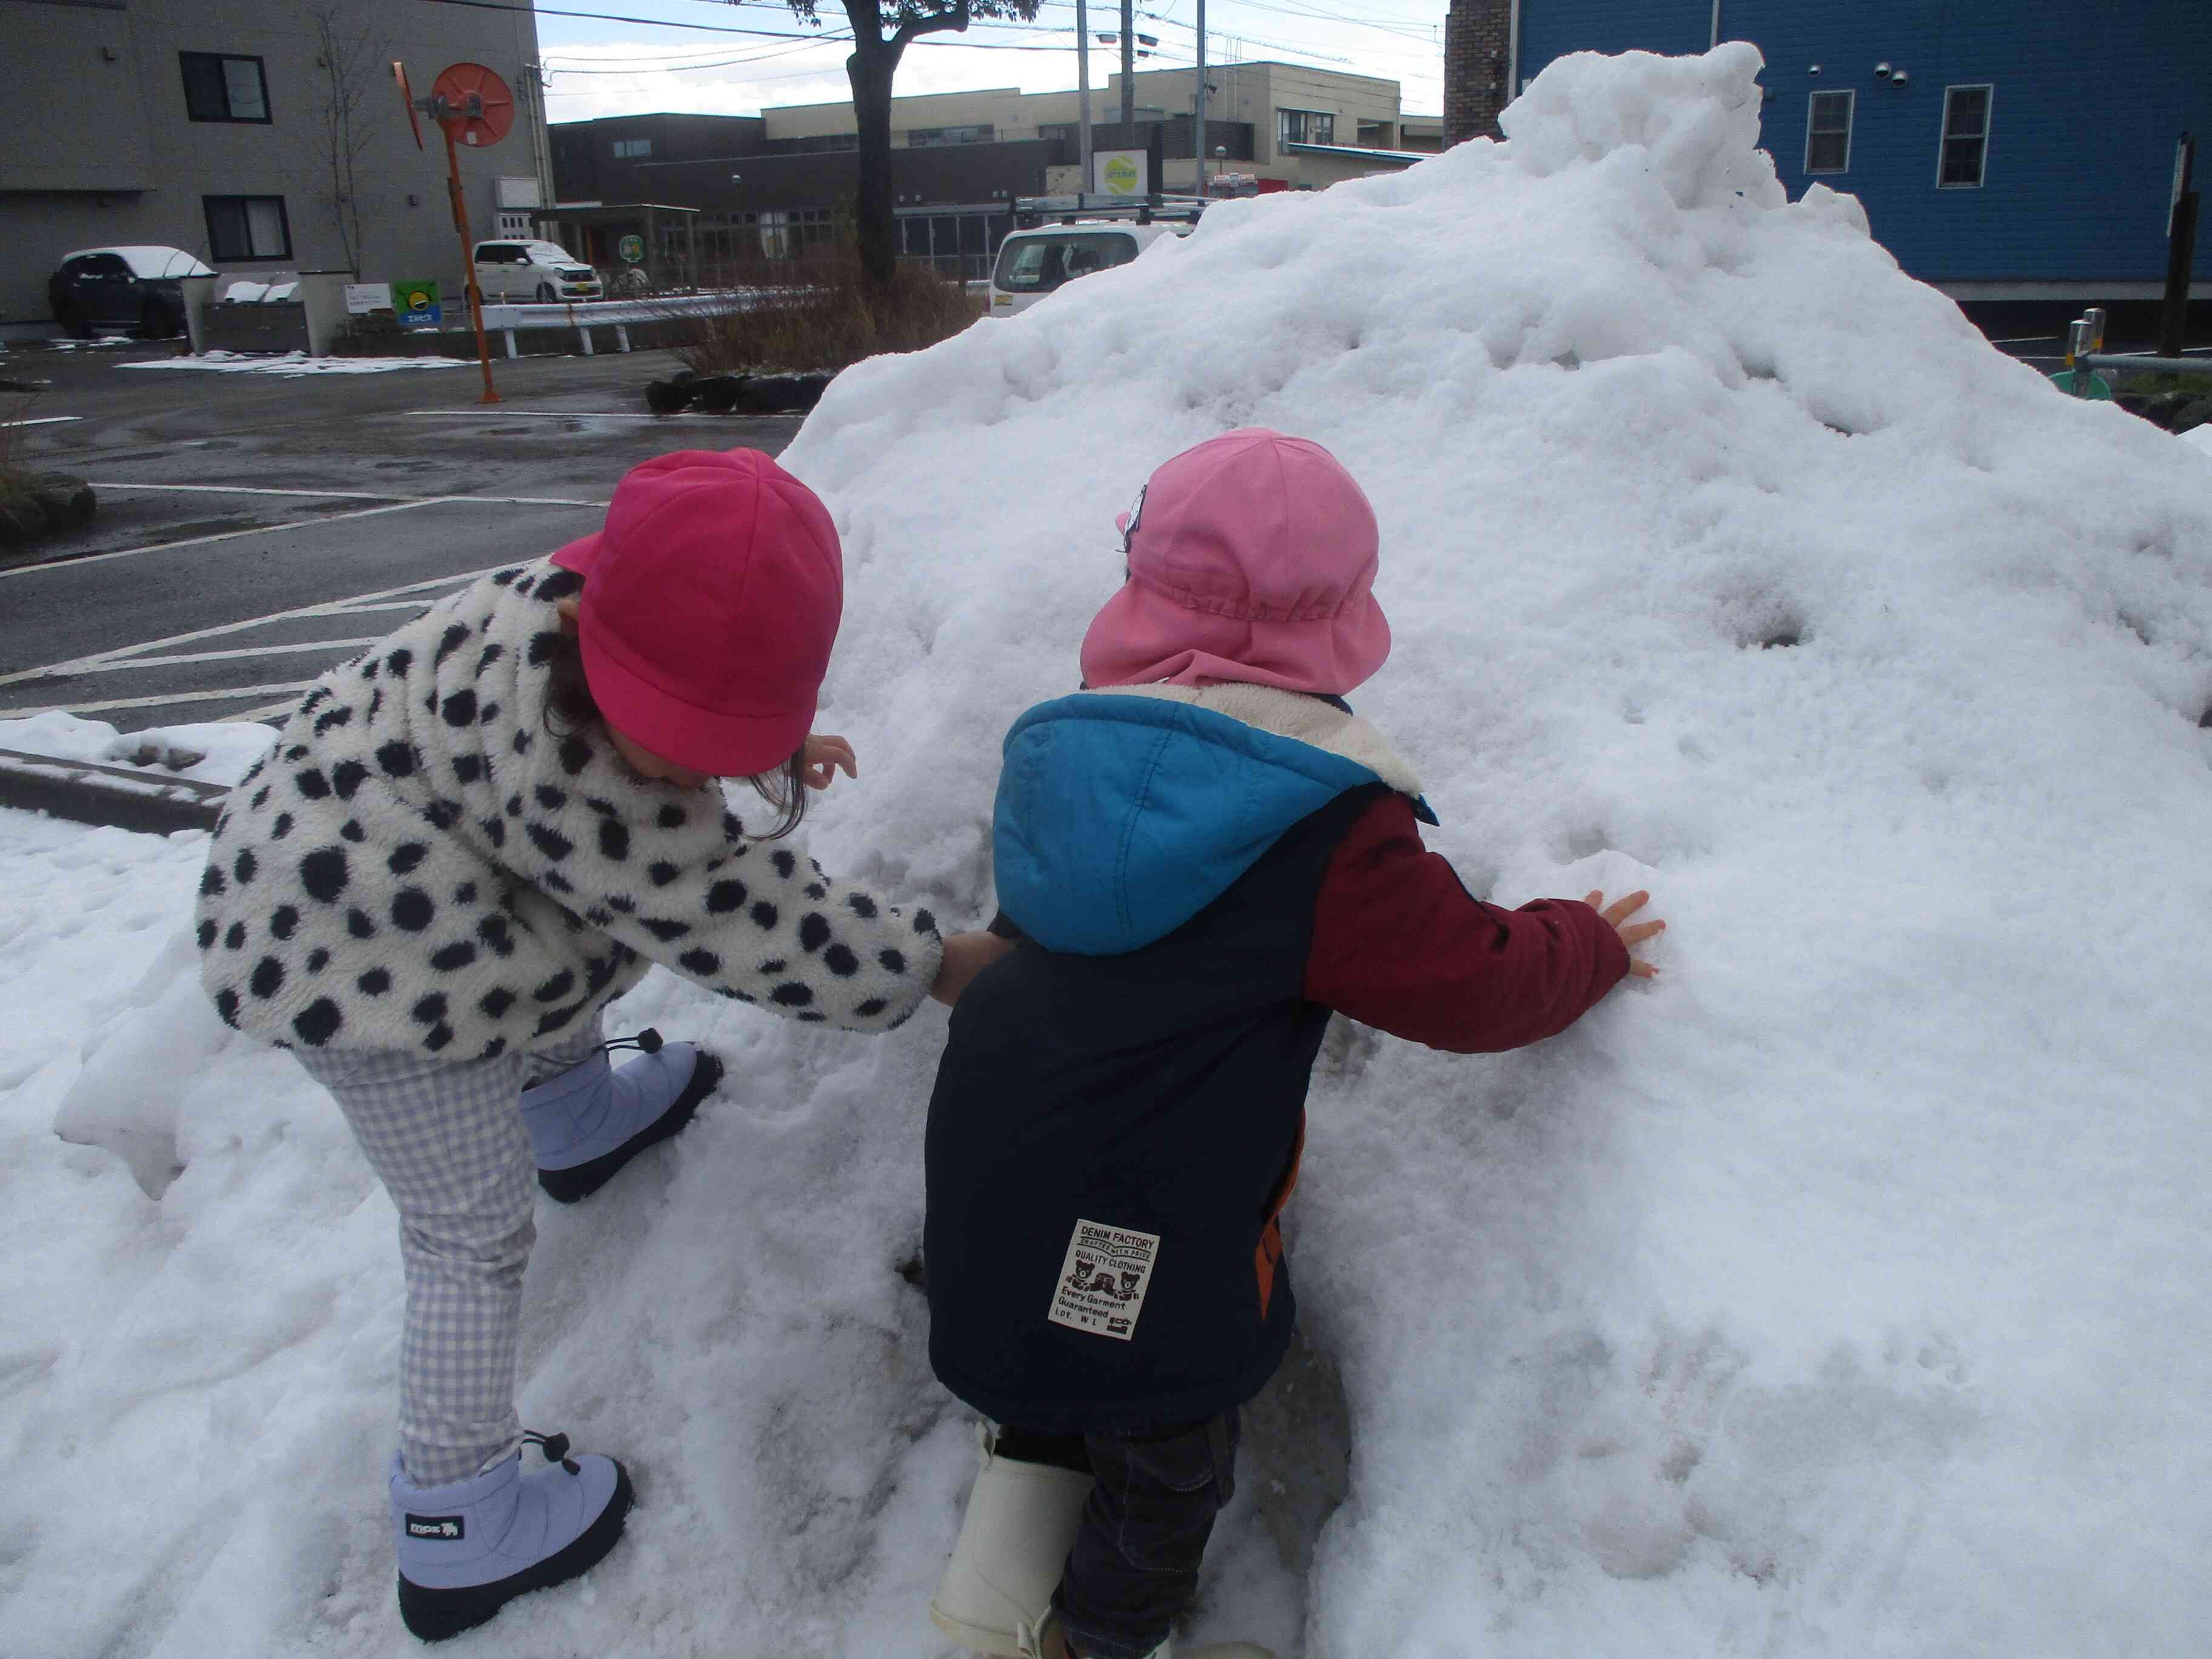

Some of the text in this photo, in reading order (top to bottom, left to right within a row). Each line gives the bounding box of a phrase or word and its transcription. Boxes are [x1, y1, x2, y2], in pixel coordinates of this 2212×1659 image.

[1081, 1226, 1155, 1249] DENIM FACTORY
[1081, 1238, 1110, 1250] CRAFTED
[1131, 1250, 1150, 1259] PRIDE
[1075, 1250, 1145, 1273] QUALITY CLOTHING
[1058, 1296, 1109, 1318] Guaranteed
[1062, 1286, 1126, 1310] Every Garment
[1081, 1315, 1089, 1323] W
